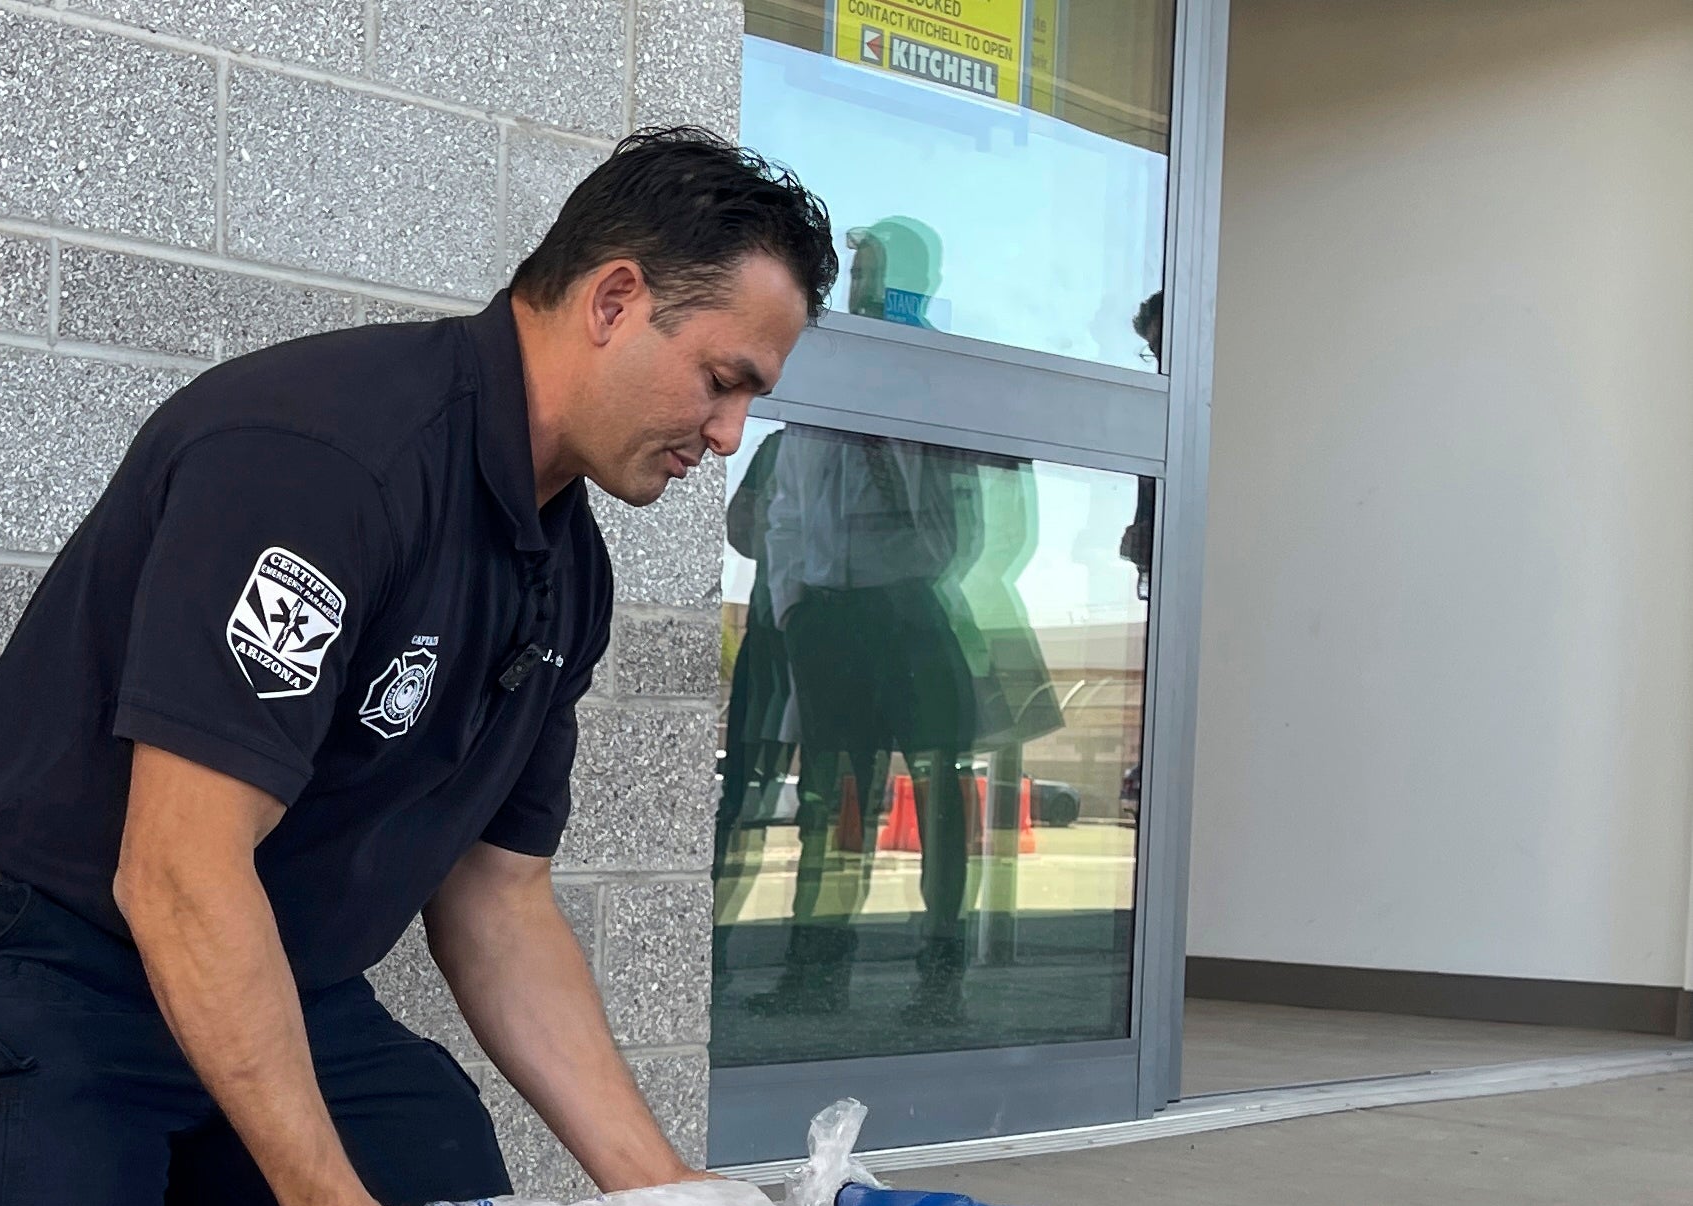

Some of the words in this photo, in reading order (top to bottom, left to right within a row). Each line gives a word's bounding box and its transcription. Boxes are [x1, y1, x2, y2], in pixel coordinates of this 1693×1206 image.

[848, 0, 904, 28] CONTACT
[908, 16, 962, 46] KITCHELL
[965, 34, 980, 51] TO
[982, 40, 1013, 61] OPEN
[892, 39, 996, 94] KITCHELL
[269, 553, 341, 610] CERTIFIED
[235, 641, 302, 688] ARIZONA
